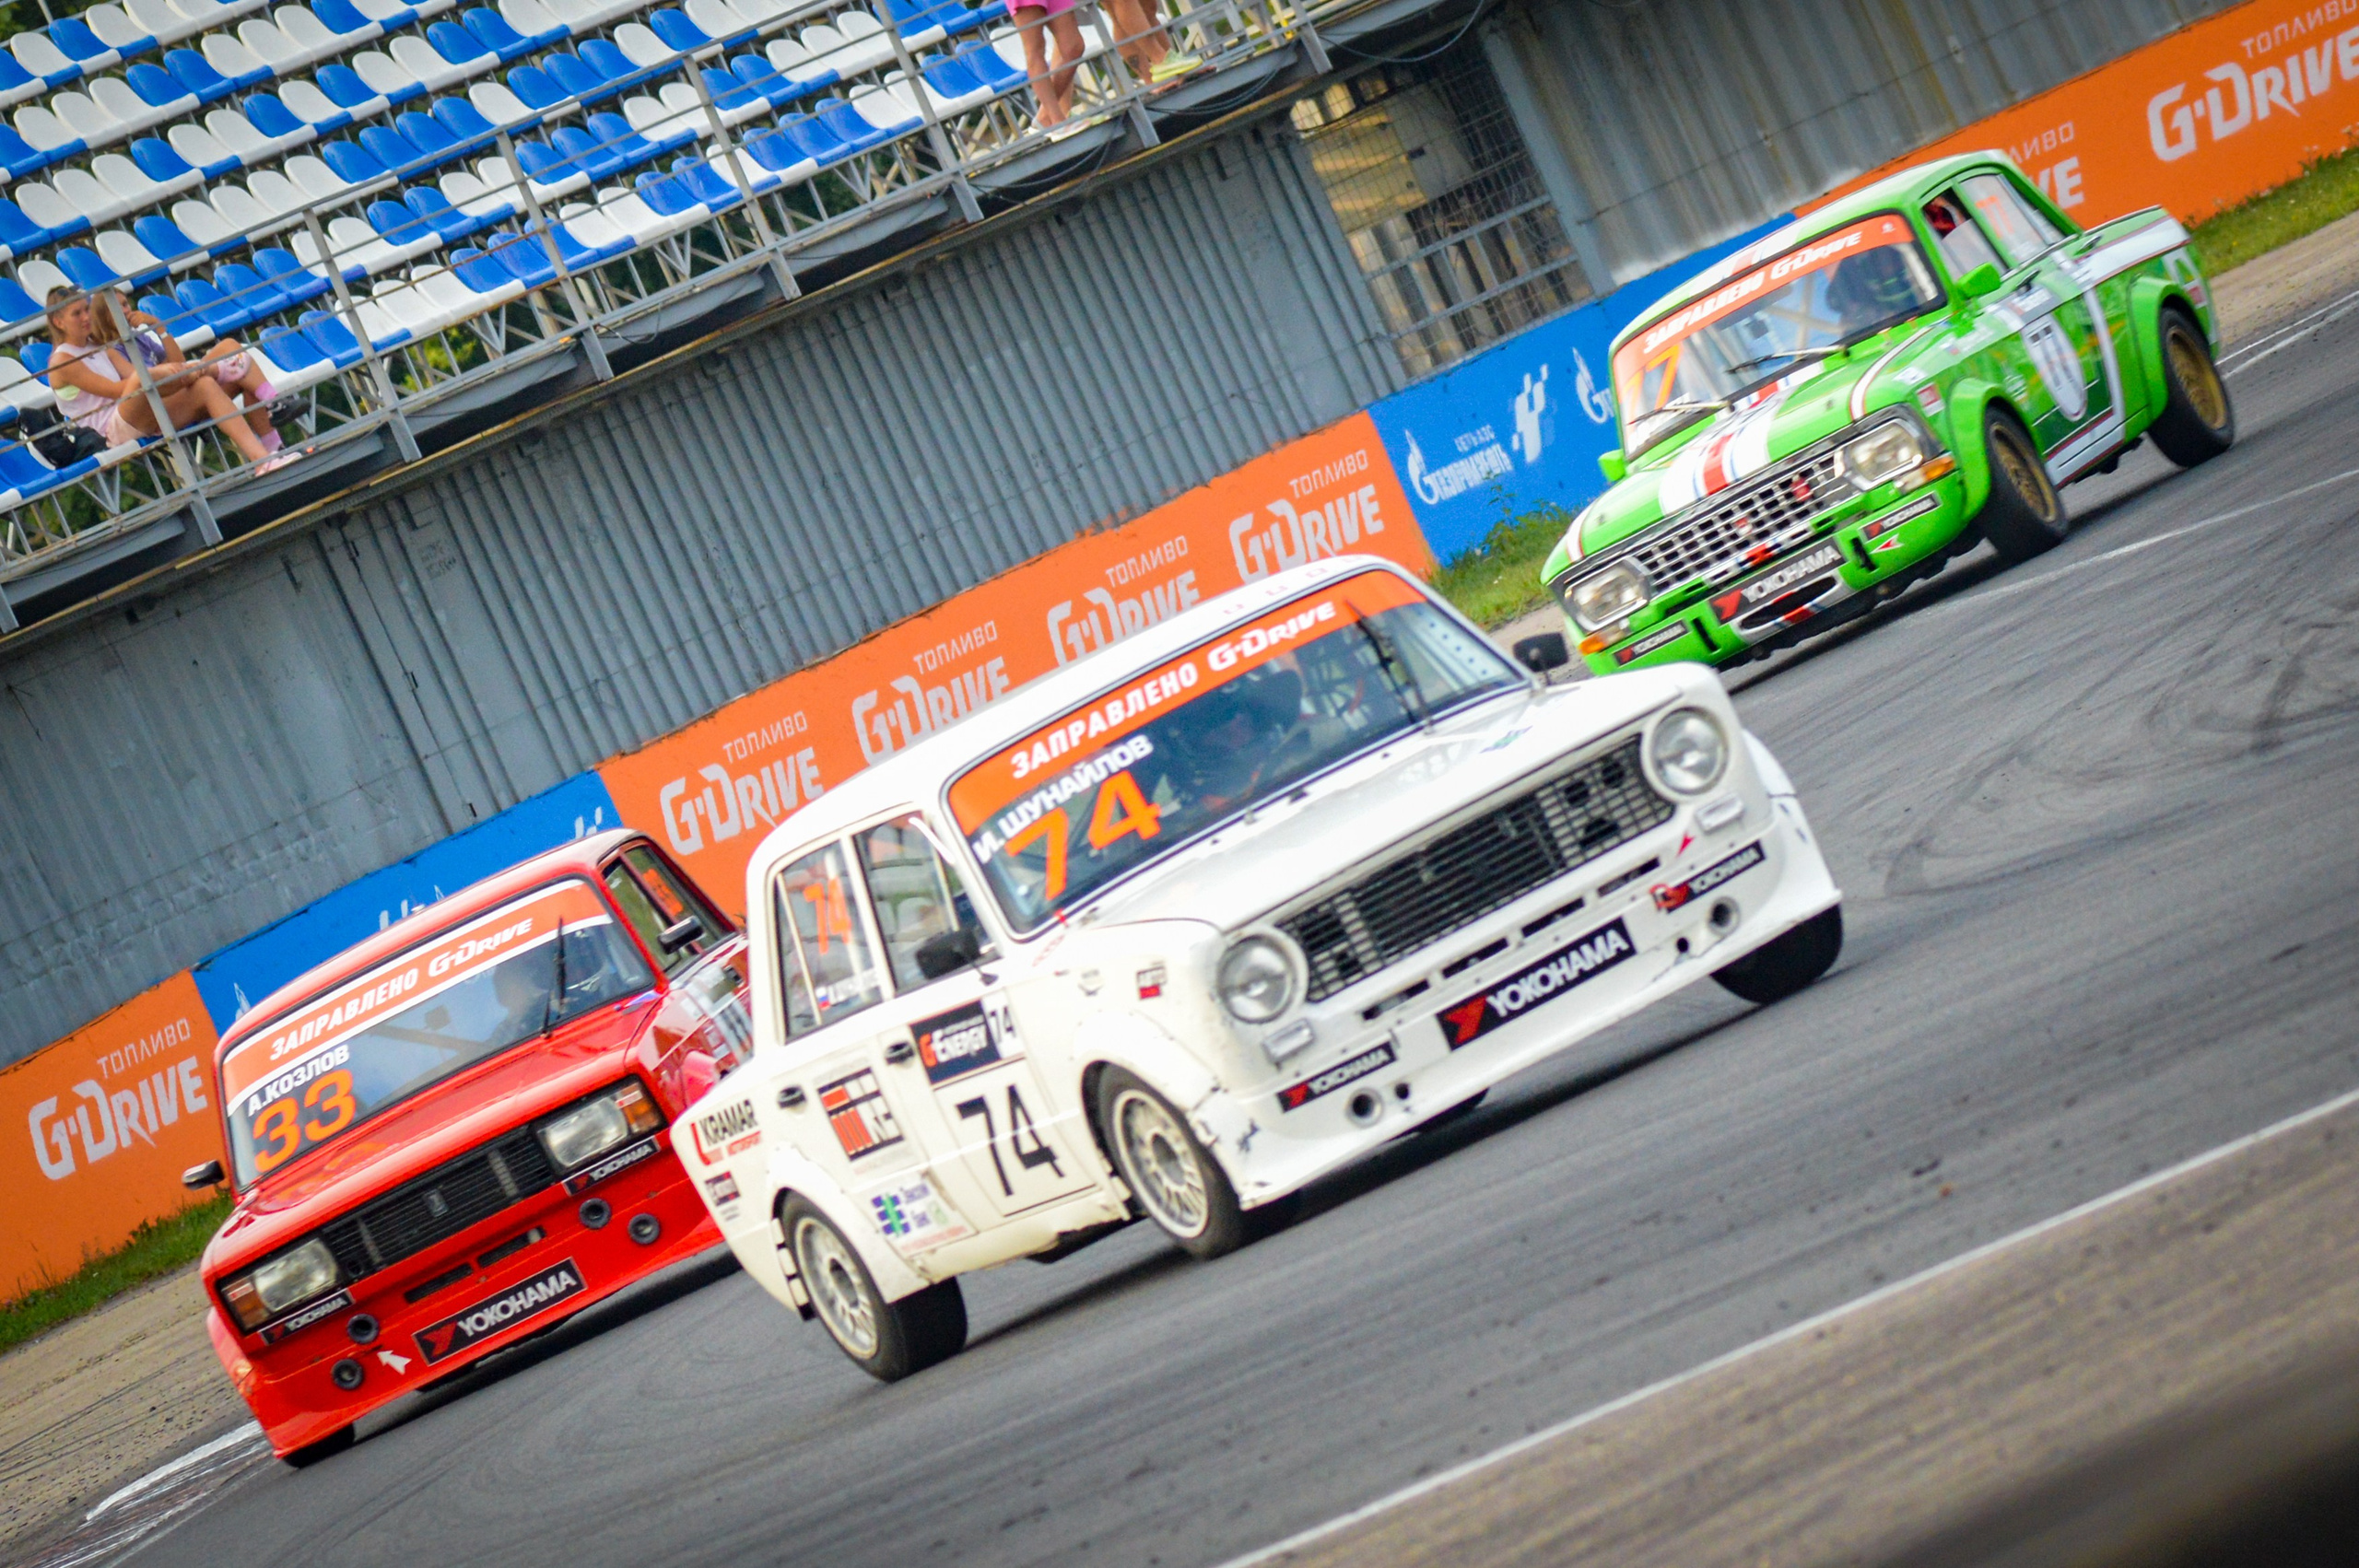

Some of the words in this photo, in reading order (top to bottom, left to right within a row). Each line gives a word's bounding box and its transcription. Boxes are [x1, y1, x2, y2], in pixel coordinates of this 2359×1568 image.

[2240, 0, 2357, 59] ТОПЛИВО
[2010, 121, 2075, 164] ЛИВО
[1289, 449, 1368, 499] ТОПЛИВО
[1106, 534, 1189, 589] ТОПЛИВО
[1741, 544, 1842, 603] YOKOHAMA
[913, 619, 998, 674] ТОПЛИВО
[722, 710, 808, 764] ТОПЛИВО
[1011, 661, 1199, 779] ЗАПРАВЛЕНО
[1003, 769, 1161, 901] 74
[1690, 845, 1760, 896] YOKOHAMA
[803, 876, 852, 955] 74
[1486, 927, 1629, 1018] YOKOHAMA
[269, 967, 418, 1061] ЗАПРАВЛЕНО
[97, 1017, 192, 1080] ТОПЛИВО
[1308, 1047, 1391, 1096] YOKOHAMA
[247, 1044, 350, 1117] А.КОЗЛОВ
[252, 1069, 357, 1174] 33
[955, 1083, 1065, 1196] 74
[589, 1144, 652, 1181] YOKOHAMA
[288, 1296, 346, 1332] YOKOHAMA
[458, 1268, 577, 1337] YOKOHAMA
